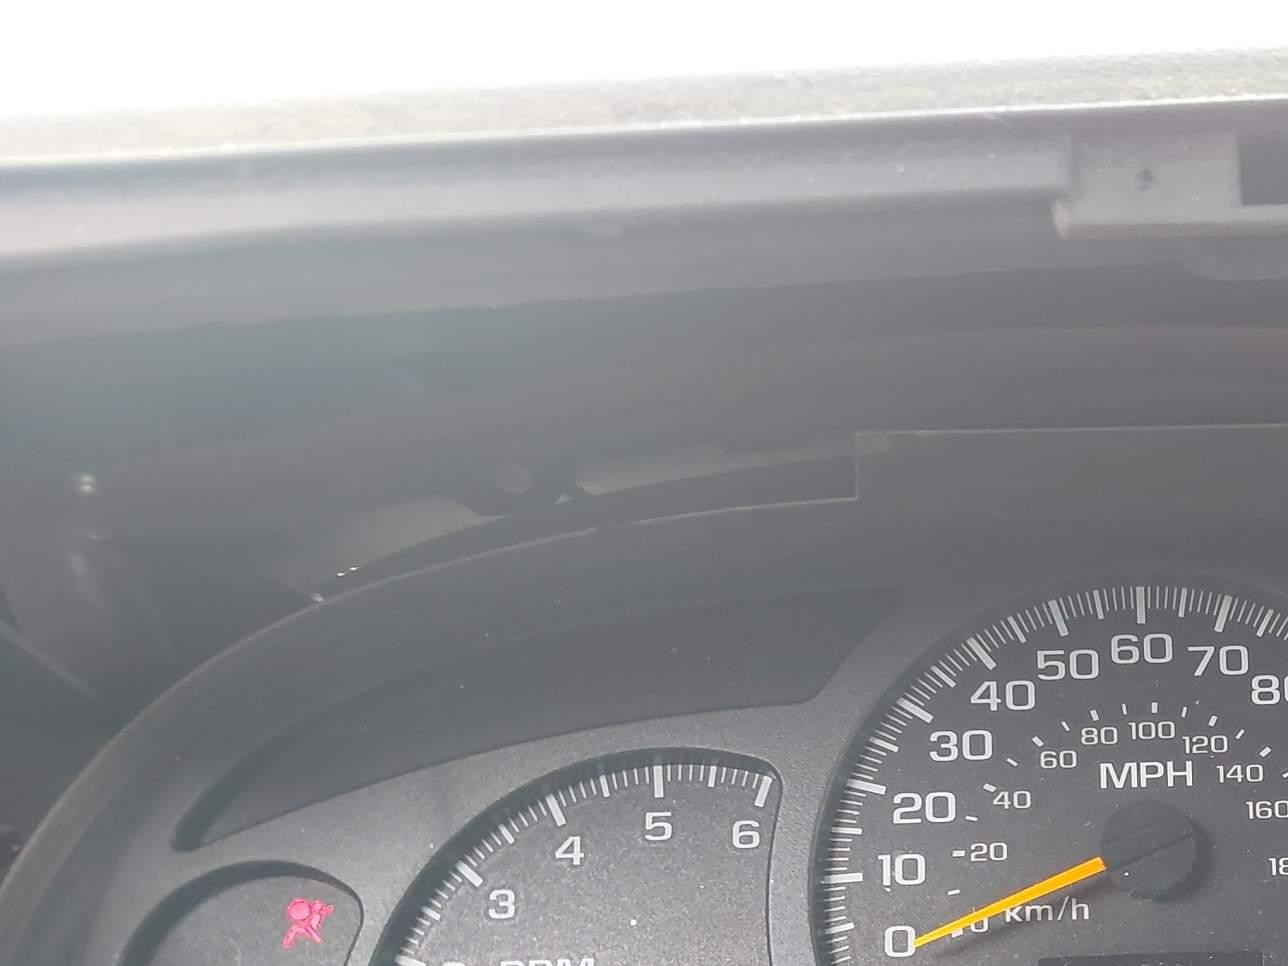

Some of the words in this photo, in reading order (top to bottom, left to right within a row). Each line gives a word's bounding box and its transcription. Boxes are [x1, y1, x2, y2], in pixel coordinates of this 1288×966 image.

[1111, 633, 1173, 664] 60
[1187, 645, 1249, 676] 70
[1037, 649, 1099, 681] 50
[970, 680, 1036, 712] 40
[929, 729, 993, 762] 30
[1081, 726, 1118, 745] 80
[1128, 721, 1176, 740] 100
[1182, 735, 1228, 754] 120
[1040, 750, 1077, 769] 60
[1100, 760, 1193, 789] MPH
[1216, 764, 1264, 783] 140
[893, 791, 956, 824] 20
[992, 790, 1031, 810] 40
[644, 811, 672, 841] 5
[732, 820, 760, 849] 6
[554, 835, 585, 866] 4
[970, 842, 1008, 862] 20
[877, 853, 926, 886] 10
[488, 889, 516, 919] 3
[1004, 896, 1090, 923] km/h
[884, 925, 917, 957] 0
